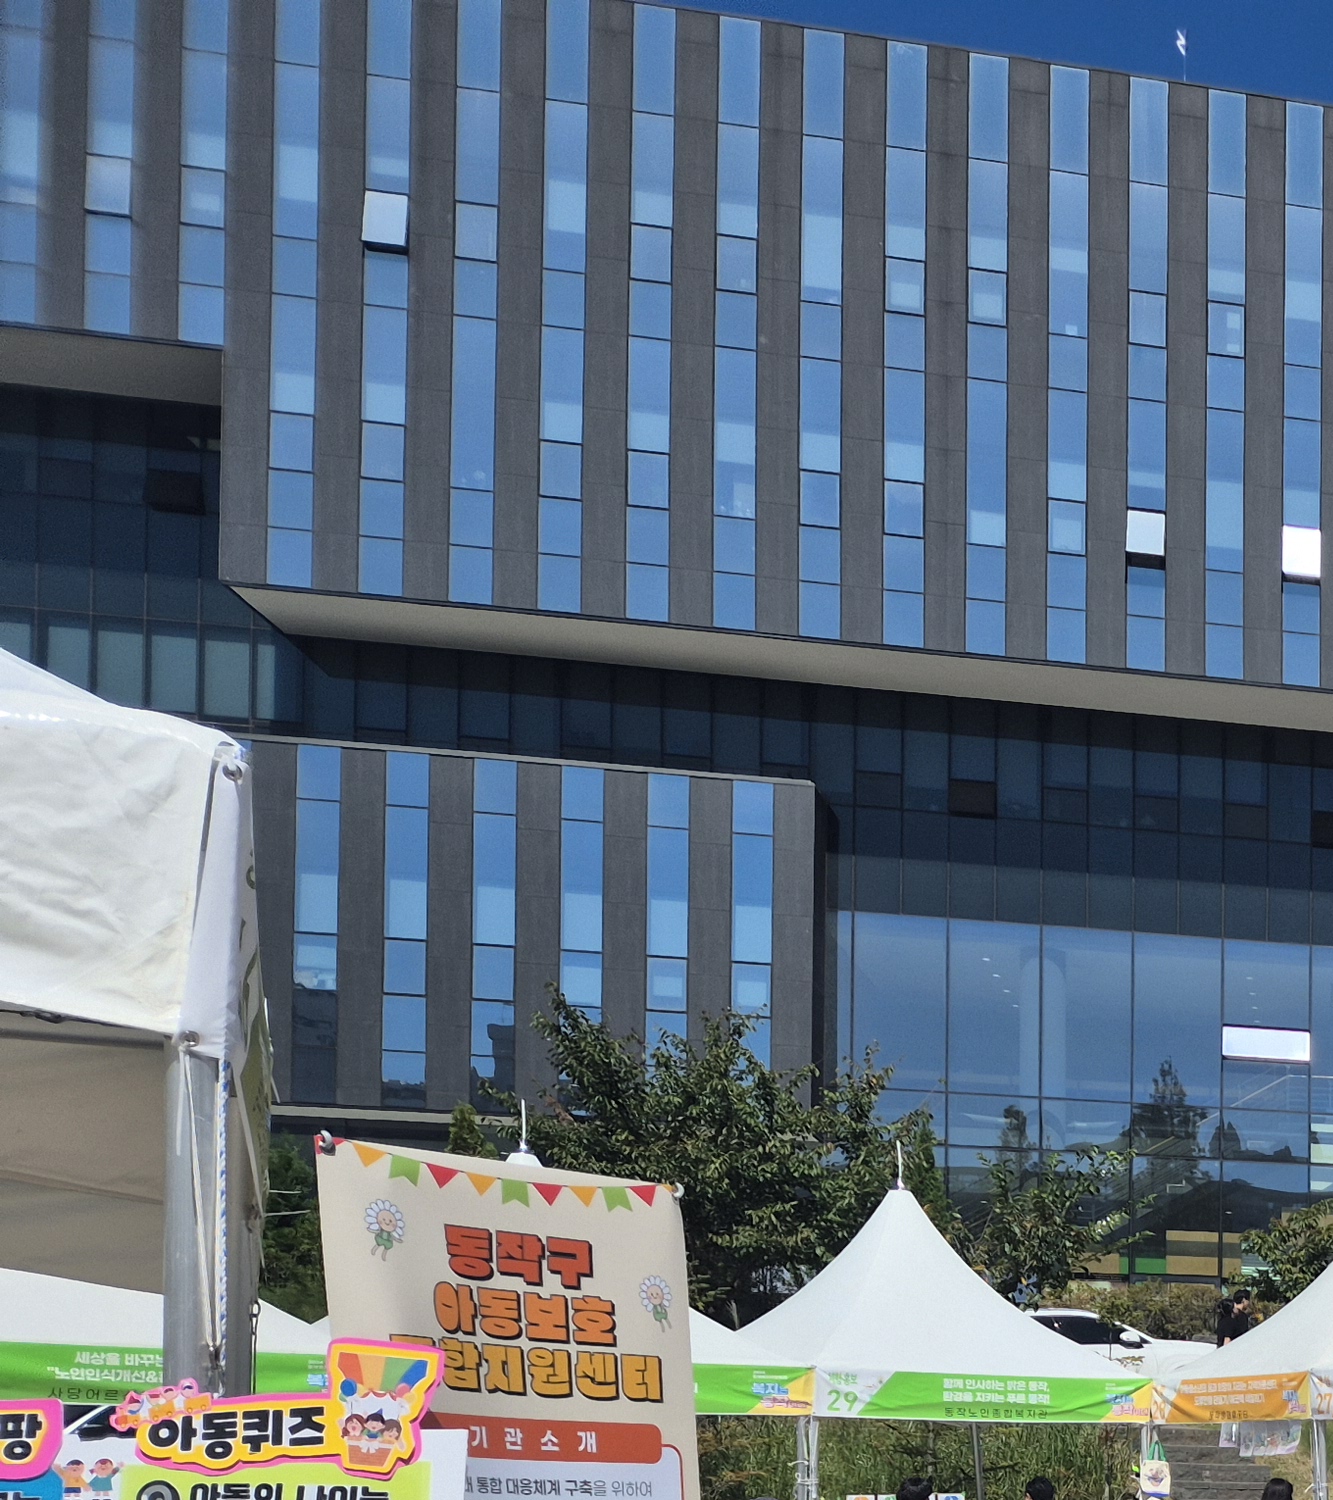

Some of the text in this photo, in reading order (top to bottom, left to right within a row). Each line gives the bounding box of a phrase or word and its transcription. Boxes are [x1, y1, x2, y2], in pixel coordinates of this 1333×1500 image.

[444, 1223, 593, 1290] 동작구
[434, 1280, 617, 1347] 아동보호
[74, 1351, 121, 1366] 세상을
[389, 1334, 664, 1403] 합지원센터
[826, 1389, 860, 1413] 29
[1315, 1392, 1333, 1415] 27
[149, 1407, 326, 1460] 아동퀴즈
[477, 1476, 502, 1495] 통합
[506, 1478, 560, 1496] 대응체계
[565, 1479, 607, 1497] 구축을
[611, 1481, 652, 1498] 위하여
